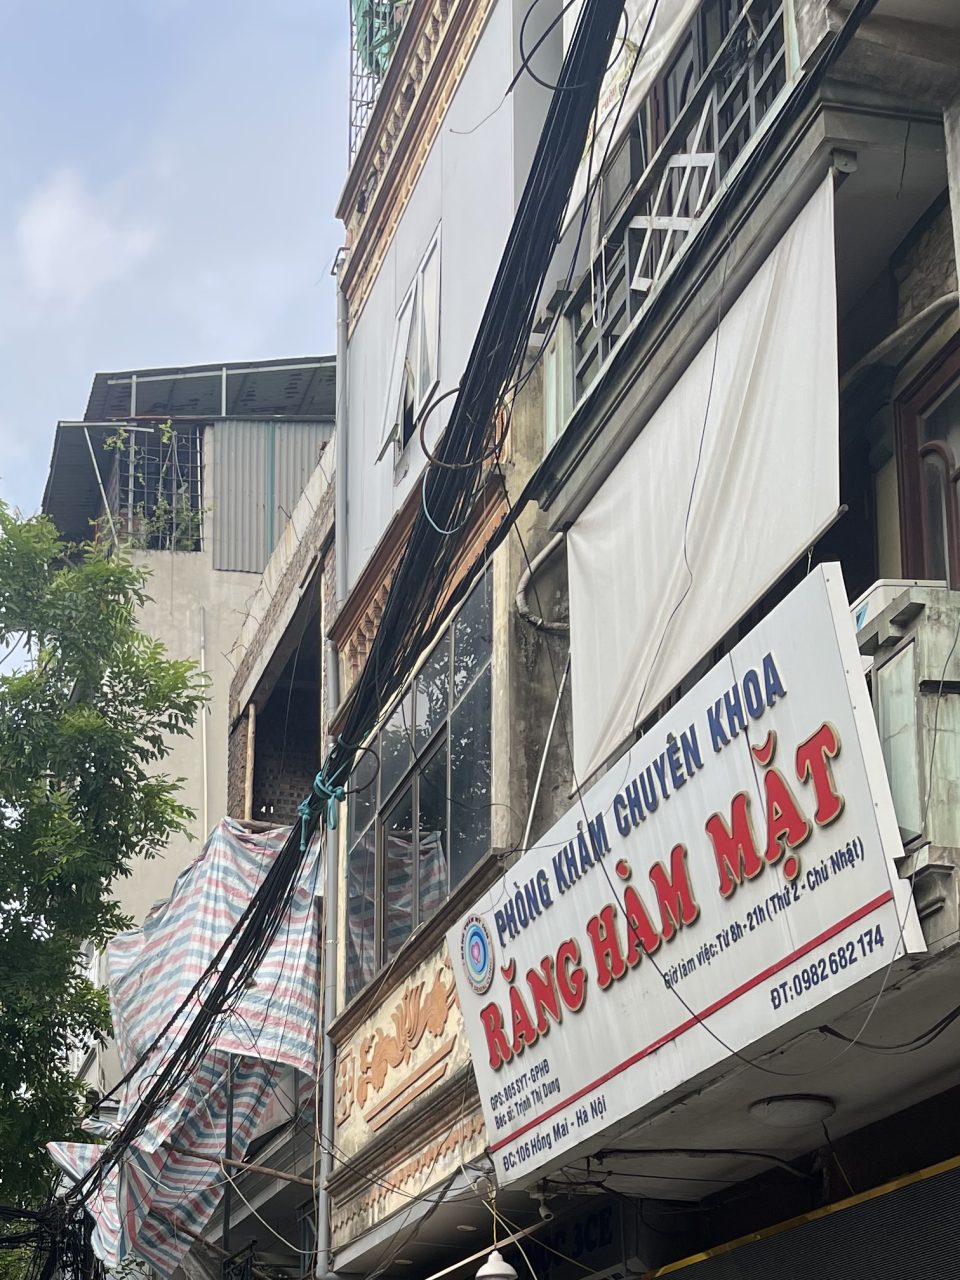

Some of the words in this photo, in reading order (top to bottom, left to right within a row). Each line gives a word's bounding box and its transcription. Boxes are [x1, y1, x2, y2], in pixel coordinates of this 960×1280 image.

[494, 869, 554, 948] PHÒNG
[613, 722, 705, 837] CHUYÊN
[706, 651, 787, 753] KHOA
[479, 936, 587, 1071] RĂNG
[704, 719, 846, 900] MẶT
[678, 955, 697, 978] làm
[828, 942, 858, 981] 682
[856, 924, 885, 958] 174
[552, 1117, 570, 1142] Mai
[575, 1105, 589, 1128] Hà
[590, 1094, 607, 1120] Nội
